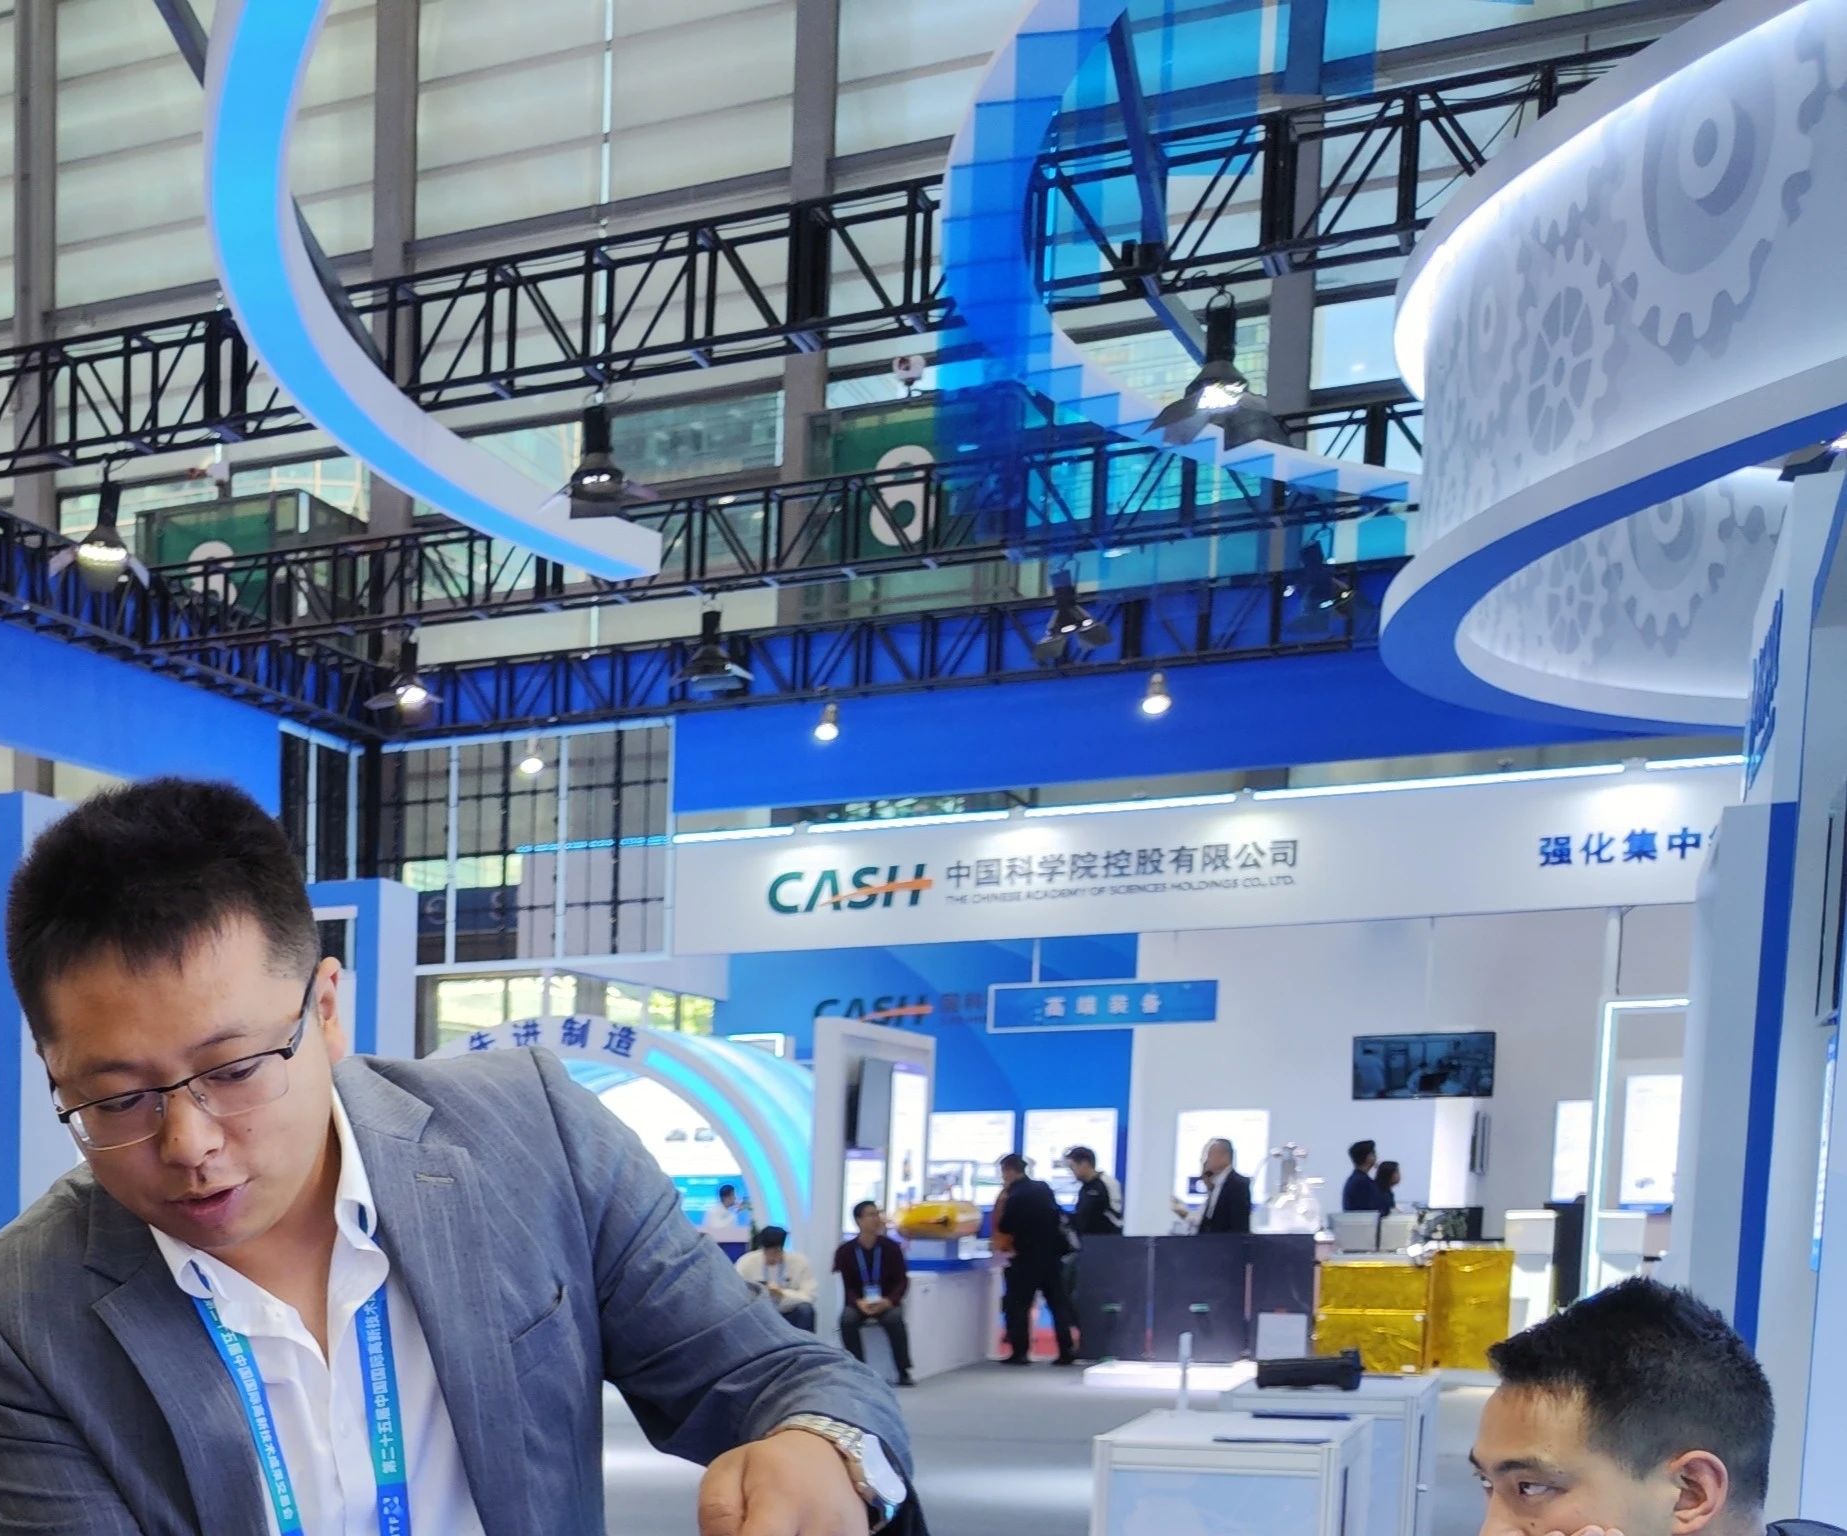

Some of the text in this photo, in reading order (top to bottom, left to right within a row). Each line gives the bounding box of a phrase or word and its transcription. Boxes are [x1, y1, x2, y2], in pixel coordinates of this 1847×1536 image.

[945, 839, 1299, 888] 中国科学院控股有限公司
[1538, 826, 1718, 867] 强化集中
[768, 863, 932, 914] CASH
[946, 893, 968, 905] THE
[972, 890, 1022, 904] CHINESE
[1026, 888, 1086, 900] ACADEMY
[1091, 886, 1107, 896] OF
[1110, 883, 1167, 894] SCIENCES
[1171, 880, 1238, 891] HOLDINGS
[469, 1017, 637, 1058] 先进制造
